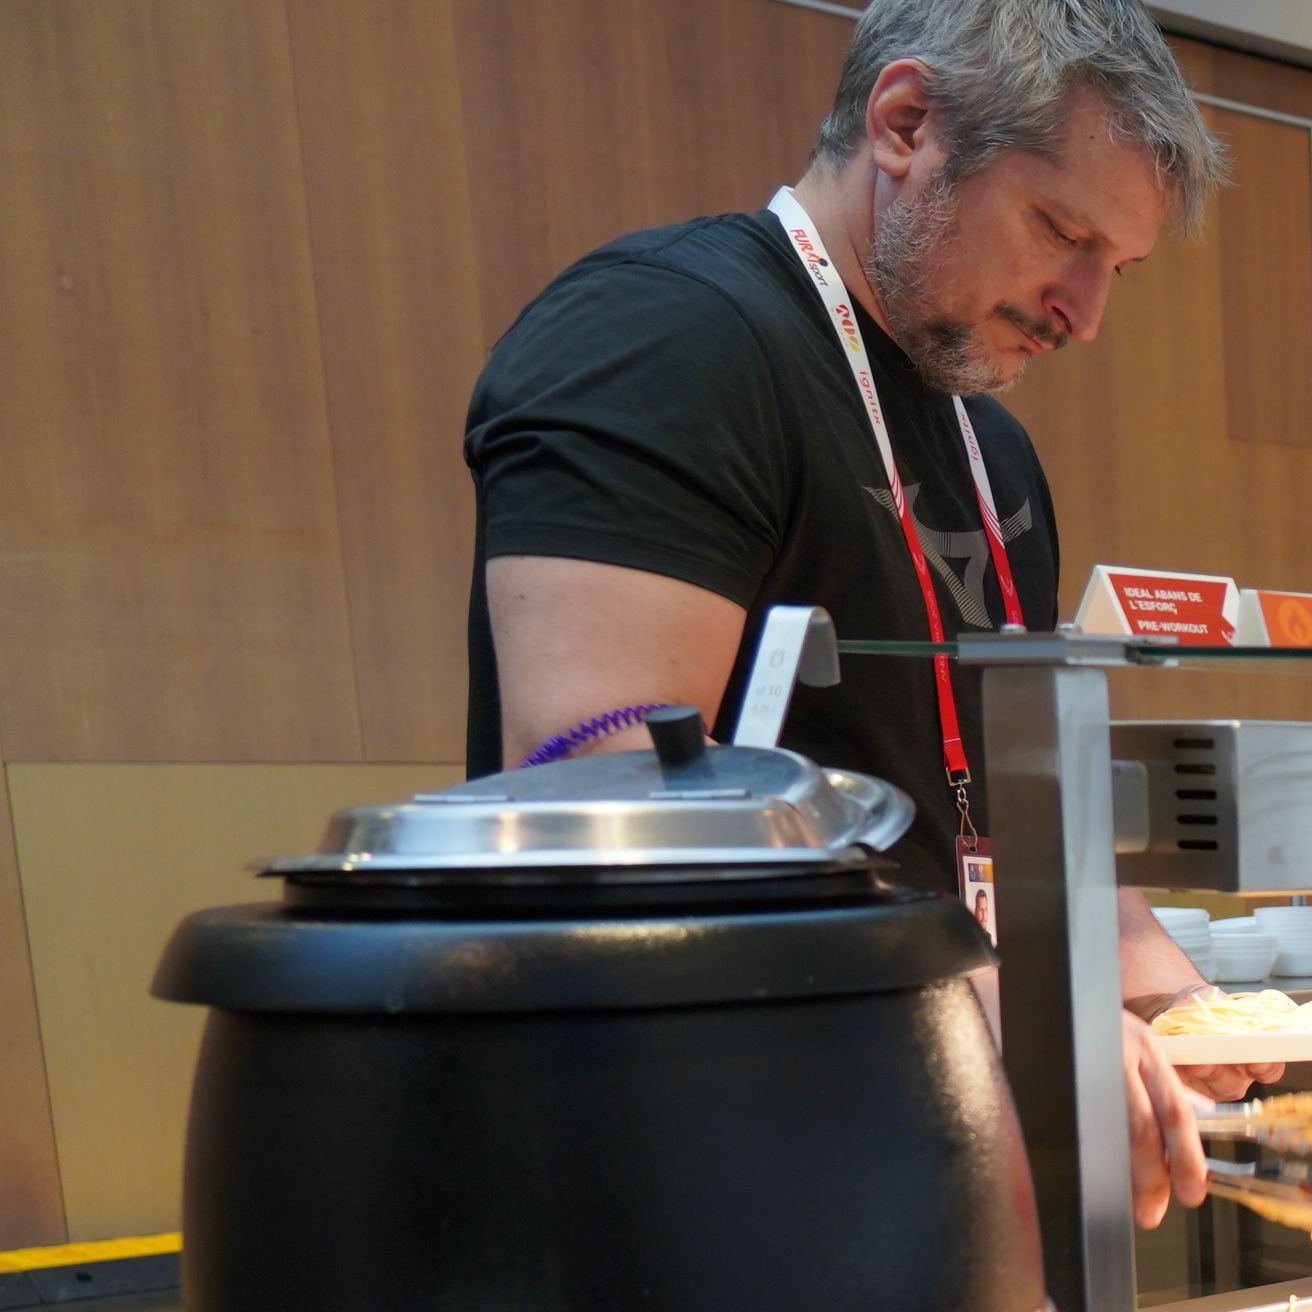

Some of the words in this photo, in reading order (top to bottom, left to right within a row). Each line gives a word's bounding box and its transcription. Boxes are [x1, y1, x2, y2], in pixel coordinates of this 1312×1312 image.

[1123, 587, 1154, 599] IDEAL
[1155, 589, 1188, 601] ABANS
[1188, 592, 1203, 602] DE
[1137, 620, 1208, 634] PRE-WORKOUT
